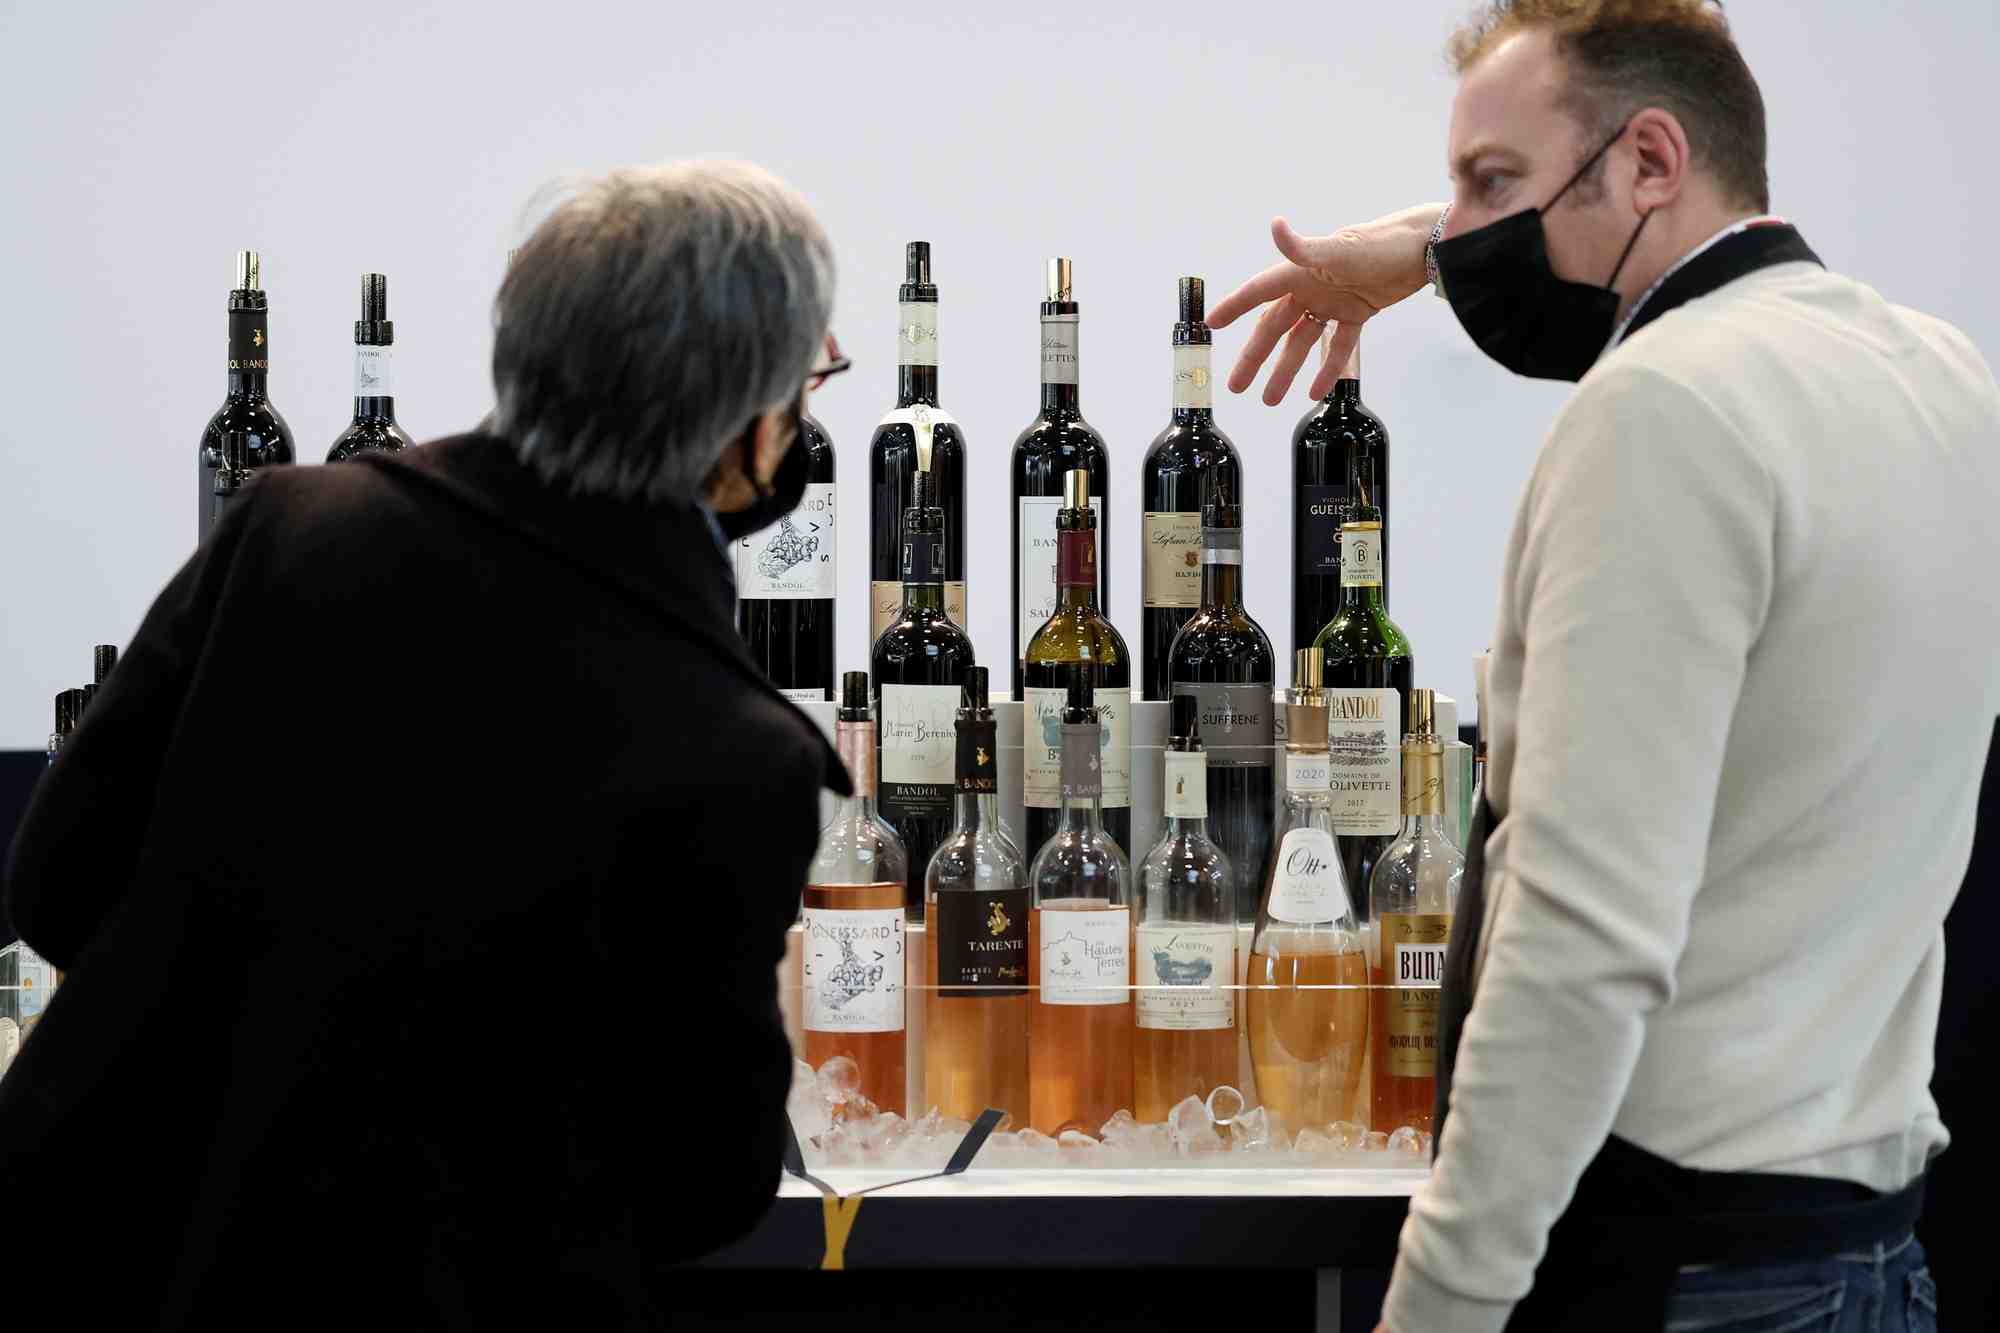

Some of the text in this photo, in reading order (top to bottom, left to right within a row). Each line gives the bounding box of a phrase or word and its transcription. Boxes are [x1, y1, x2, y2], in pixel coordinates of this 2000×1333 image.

[1295, 768, 1326, 780] 2020
[896, 786, 938, 796] BANDOL
[967, 940, 1024, 952] TARENTE
